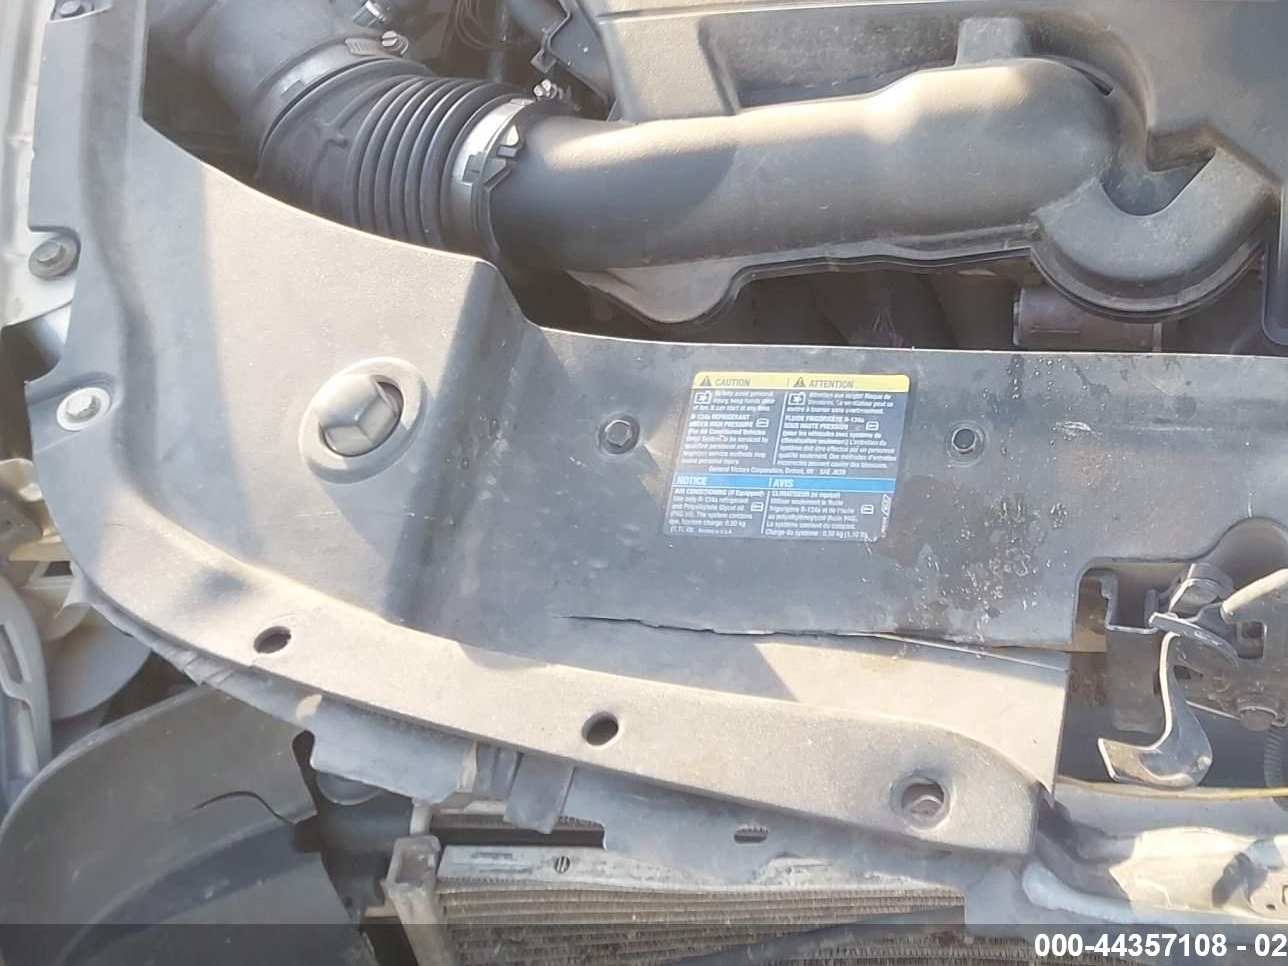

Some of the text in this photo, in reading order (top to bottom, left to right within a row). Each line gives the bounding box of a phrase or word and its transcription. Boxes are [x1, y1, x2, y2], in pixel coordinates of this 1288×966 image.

[714, 378, 750, 386] CAUTION
[808, 379, 854, 388] ATTENTION
[677, 476, 708, 485] NOTICE
[773, 479, 794, 487] AVIS
